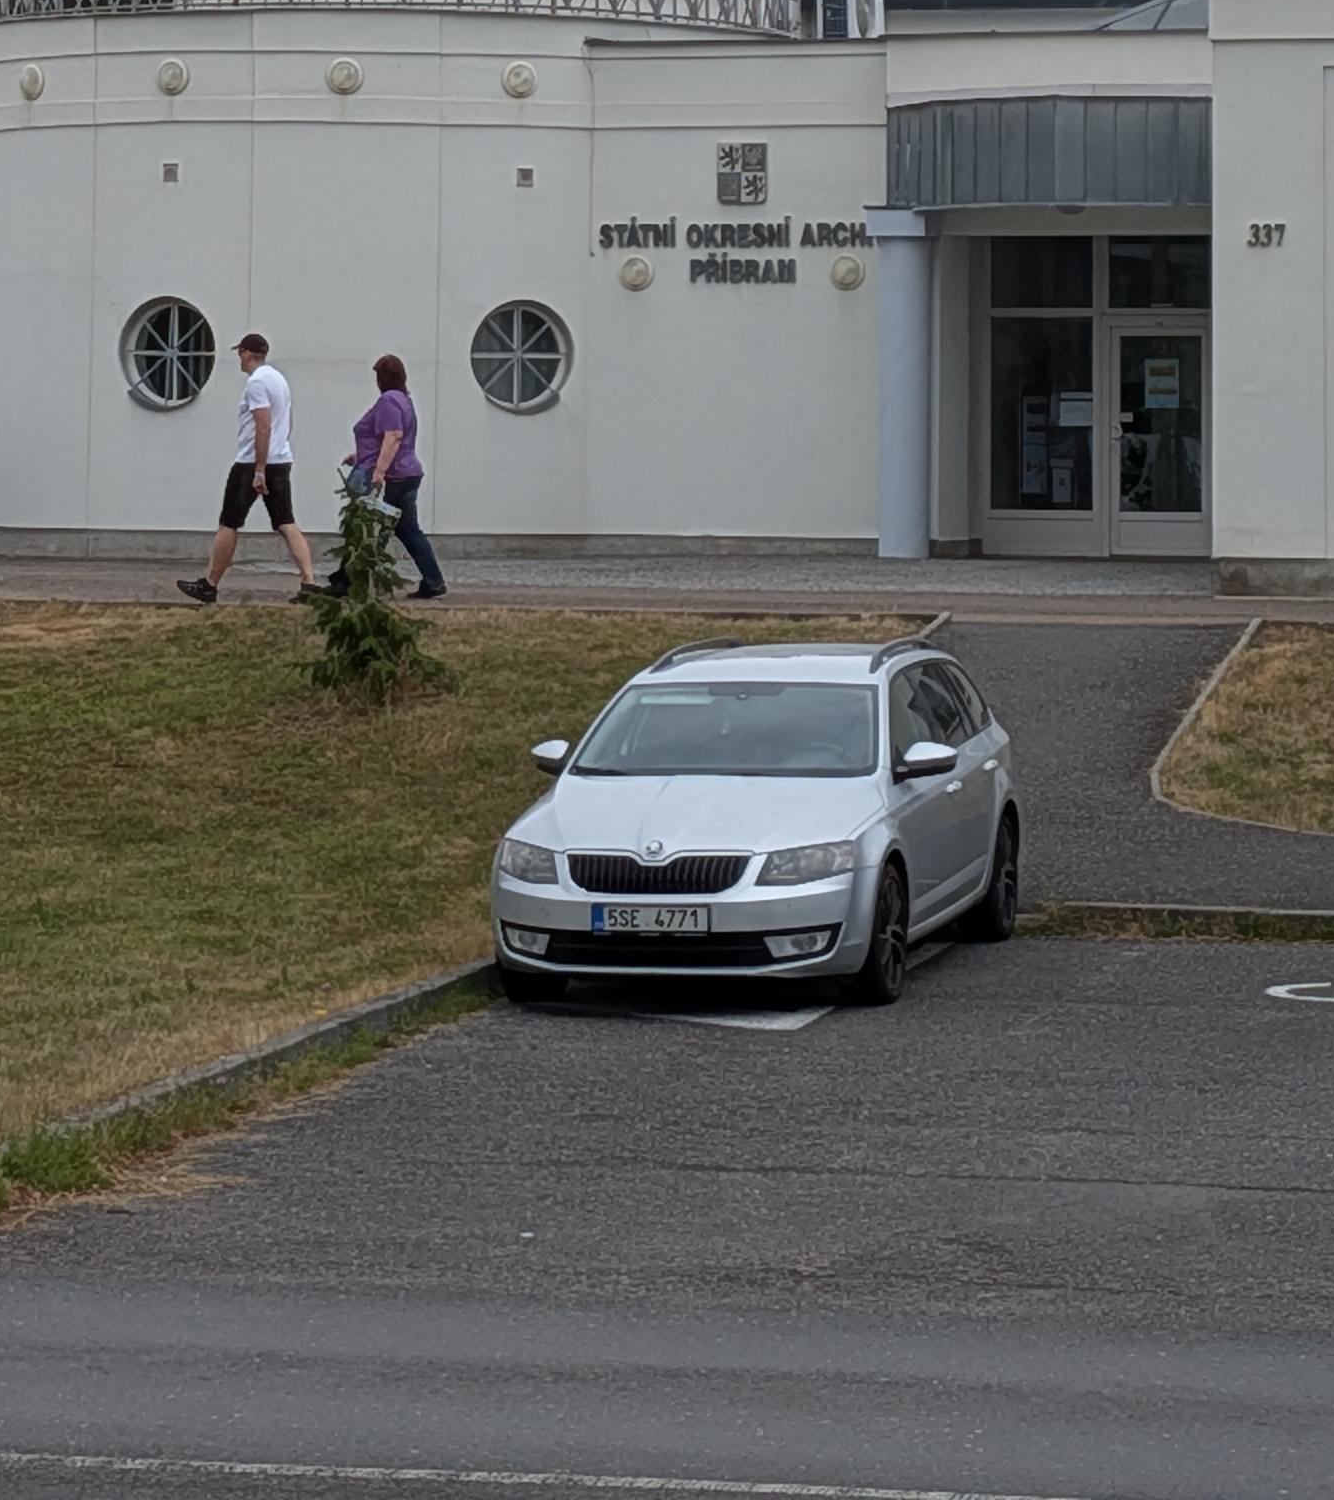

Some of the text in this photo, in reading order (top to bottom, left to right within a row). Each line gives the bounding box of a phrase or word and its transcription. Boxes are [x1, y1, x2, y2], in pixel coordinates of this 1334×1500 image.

[599, 216, 874, 248] STÁTNÍ OKRESNÍ ARCH
[1247, 223, 1286, 247] 337
[689, 252, 796, 284] PŘÍBRAM
[607, 909, 699, 928] 5SE 4771
